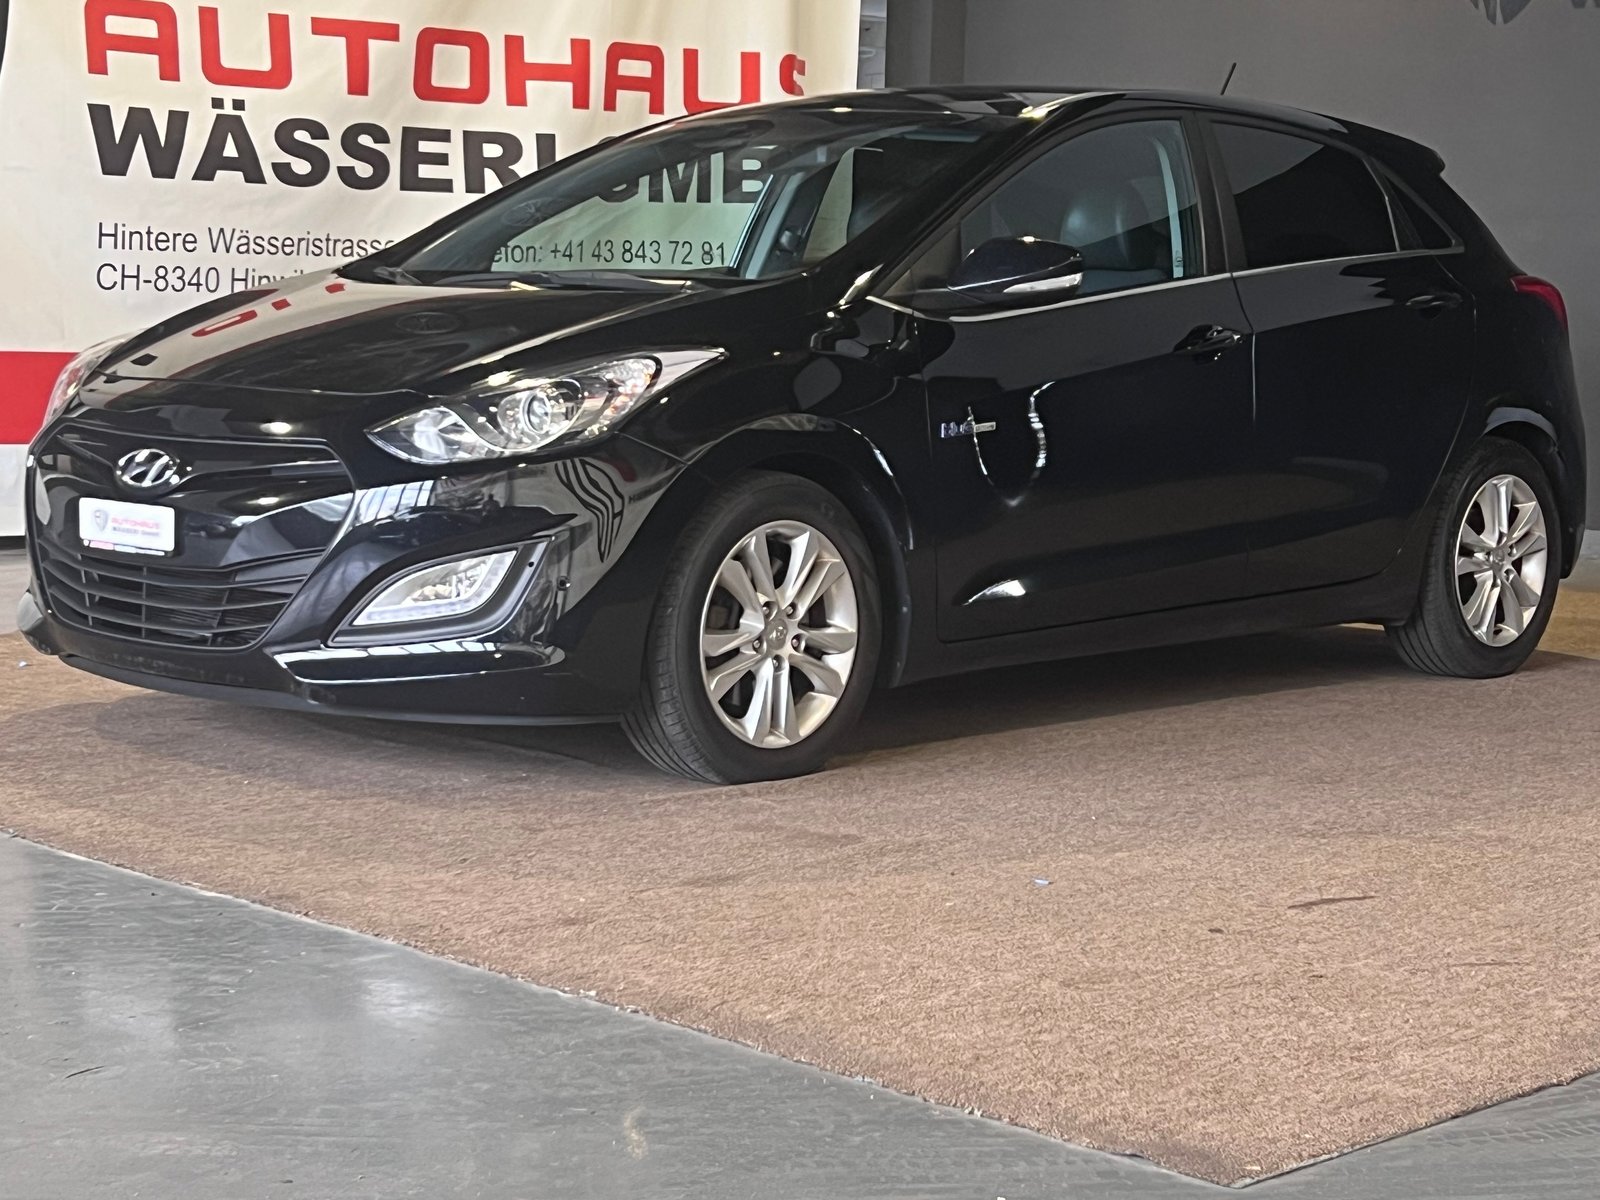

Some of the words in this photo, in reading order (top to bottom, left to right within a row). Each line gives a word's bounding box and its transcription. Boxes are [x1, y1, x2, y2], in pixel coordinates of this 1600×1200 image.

[84, 0, 806, 115] AUTOHAUS
[97, 221, 199, 253] Hintere
[550, 240, 584, 264] +41
[591, 239, 615, 263] 43
[621, 240, 662, 265] 843
[668, 240, 694, 266] 72
[700, 241, 726, 266] 81
[95, 262, 221, 293] CH-8340
